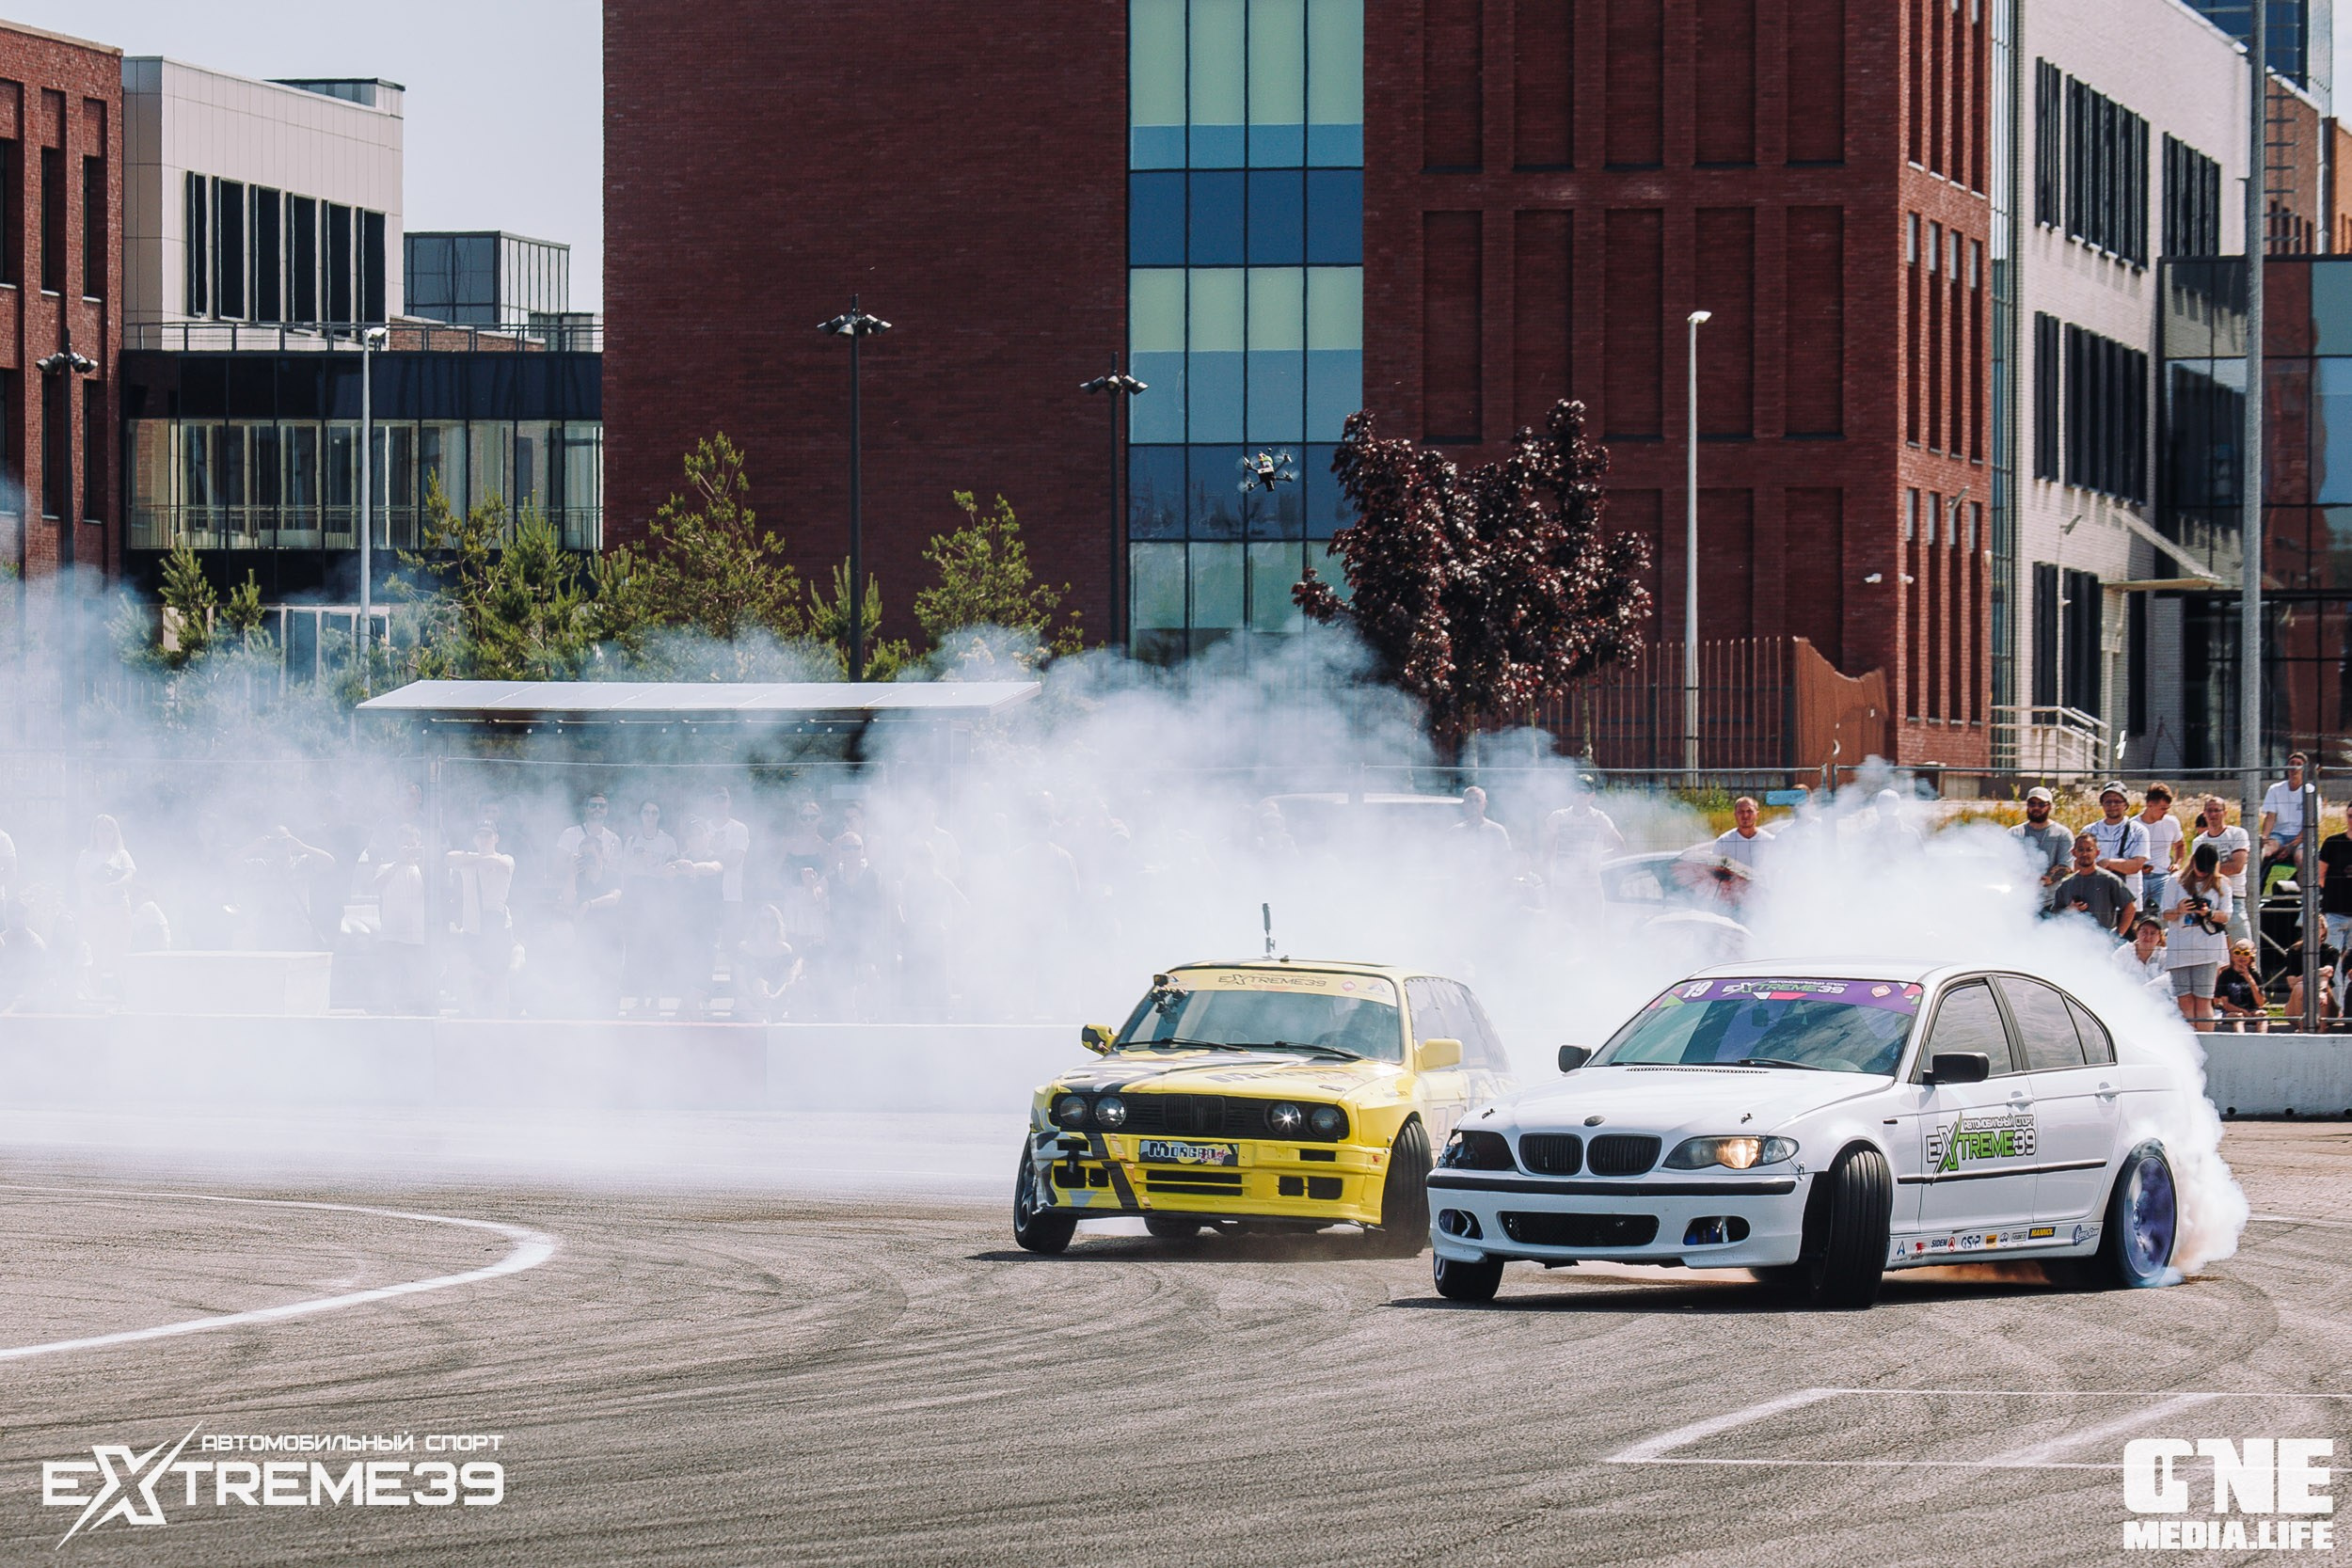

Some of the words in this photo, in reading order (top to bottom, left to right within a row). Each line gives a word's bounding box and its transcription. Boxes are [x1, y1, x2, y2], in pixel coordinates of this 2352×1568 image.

[1217, 973, 1327, 988] EXTREME39
[1682, 980, 1713, 999] 19
[1721, 980, 1846, 998] EXTREME39
[2014, 1114, 2035, 1128] СПОРТ
[1926, 1111, 2036, 1182] EXTREME39
